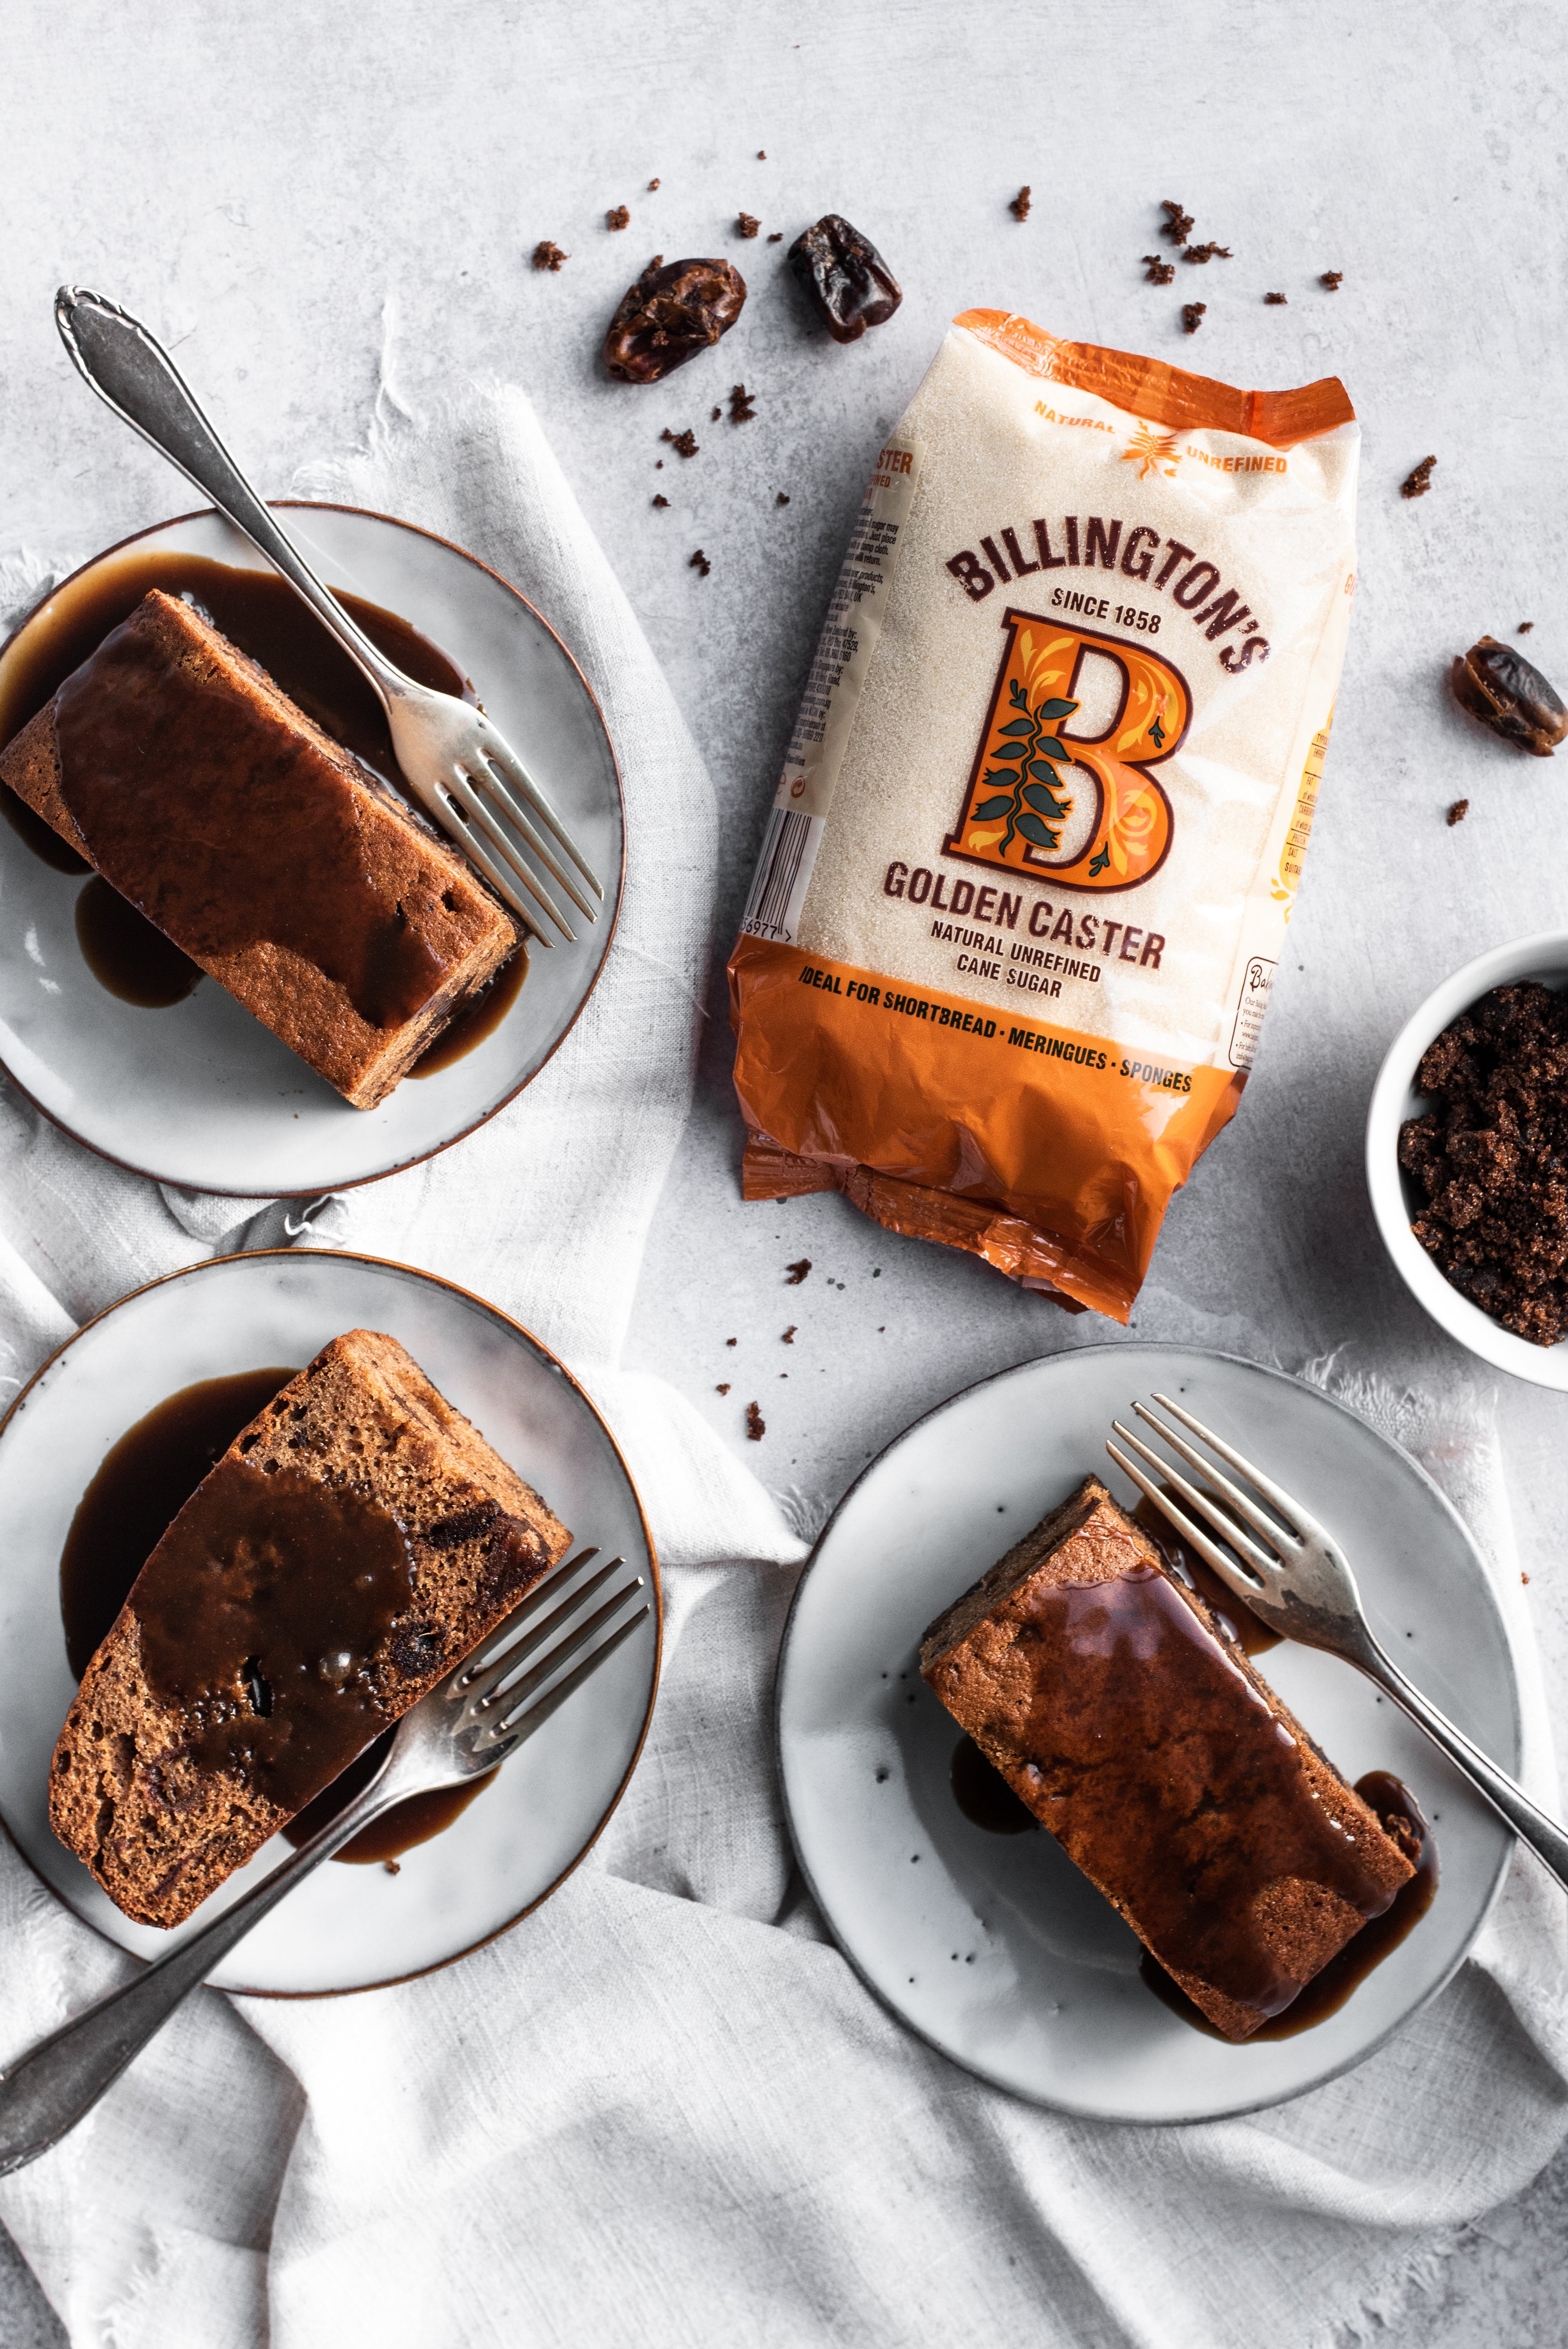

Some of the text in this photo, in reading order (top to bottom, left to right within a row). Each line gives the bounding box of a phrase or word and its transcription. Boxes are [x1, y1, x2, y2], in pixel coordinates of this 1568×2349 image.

[1034, 400, 1287, 473] NATURAL UNREFINED
[869, 530, 881, 542] Just
[881, 533, 896, 544] place
[871, 521, 886, 531] sugar
[886, 523, 899, 534] may
[874, 544, 888, 555] cloth.
[853, 592, 863, 603] UK
[859, 571, 883, 585] products,
[946, 516, 1271, 674] BILLINGTON'S
[1051, 587, 1162, 634] SINCE 1858
[1288, 847, 1298, 857] SALT
[884, 861, 1165, 971] GOLDEN CASTER
[931, 920, 1101, 983] NATURAL UNREFINED
[957, 954, 1062, 998] CANE SUGAR
[798, 966, 1193, 1093] IDEAL FOR SHORTBREAD MERINGUES SPONGES
